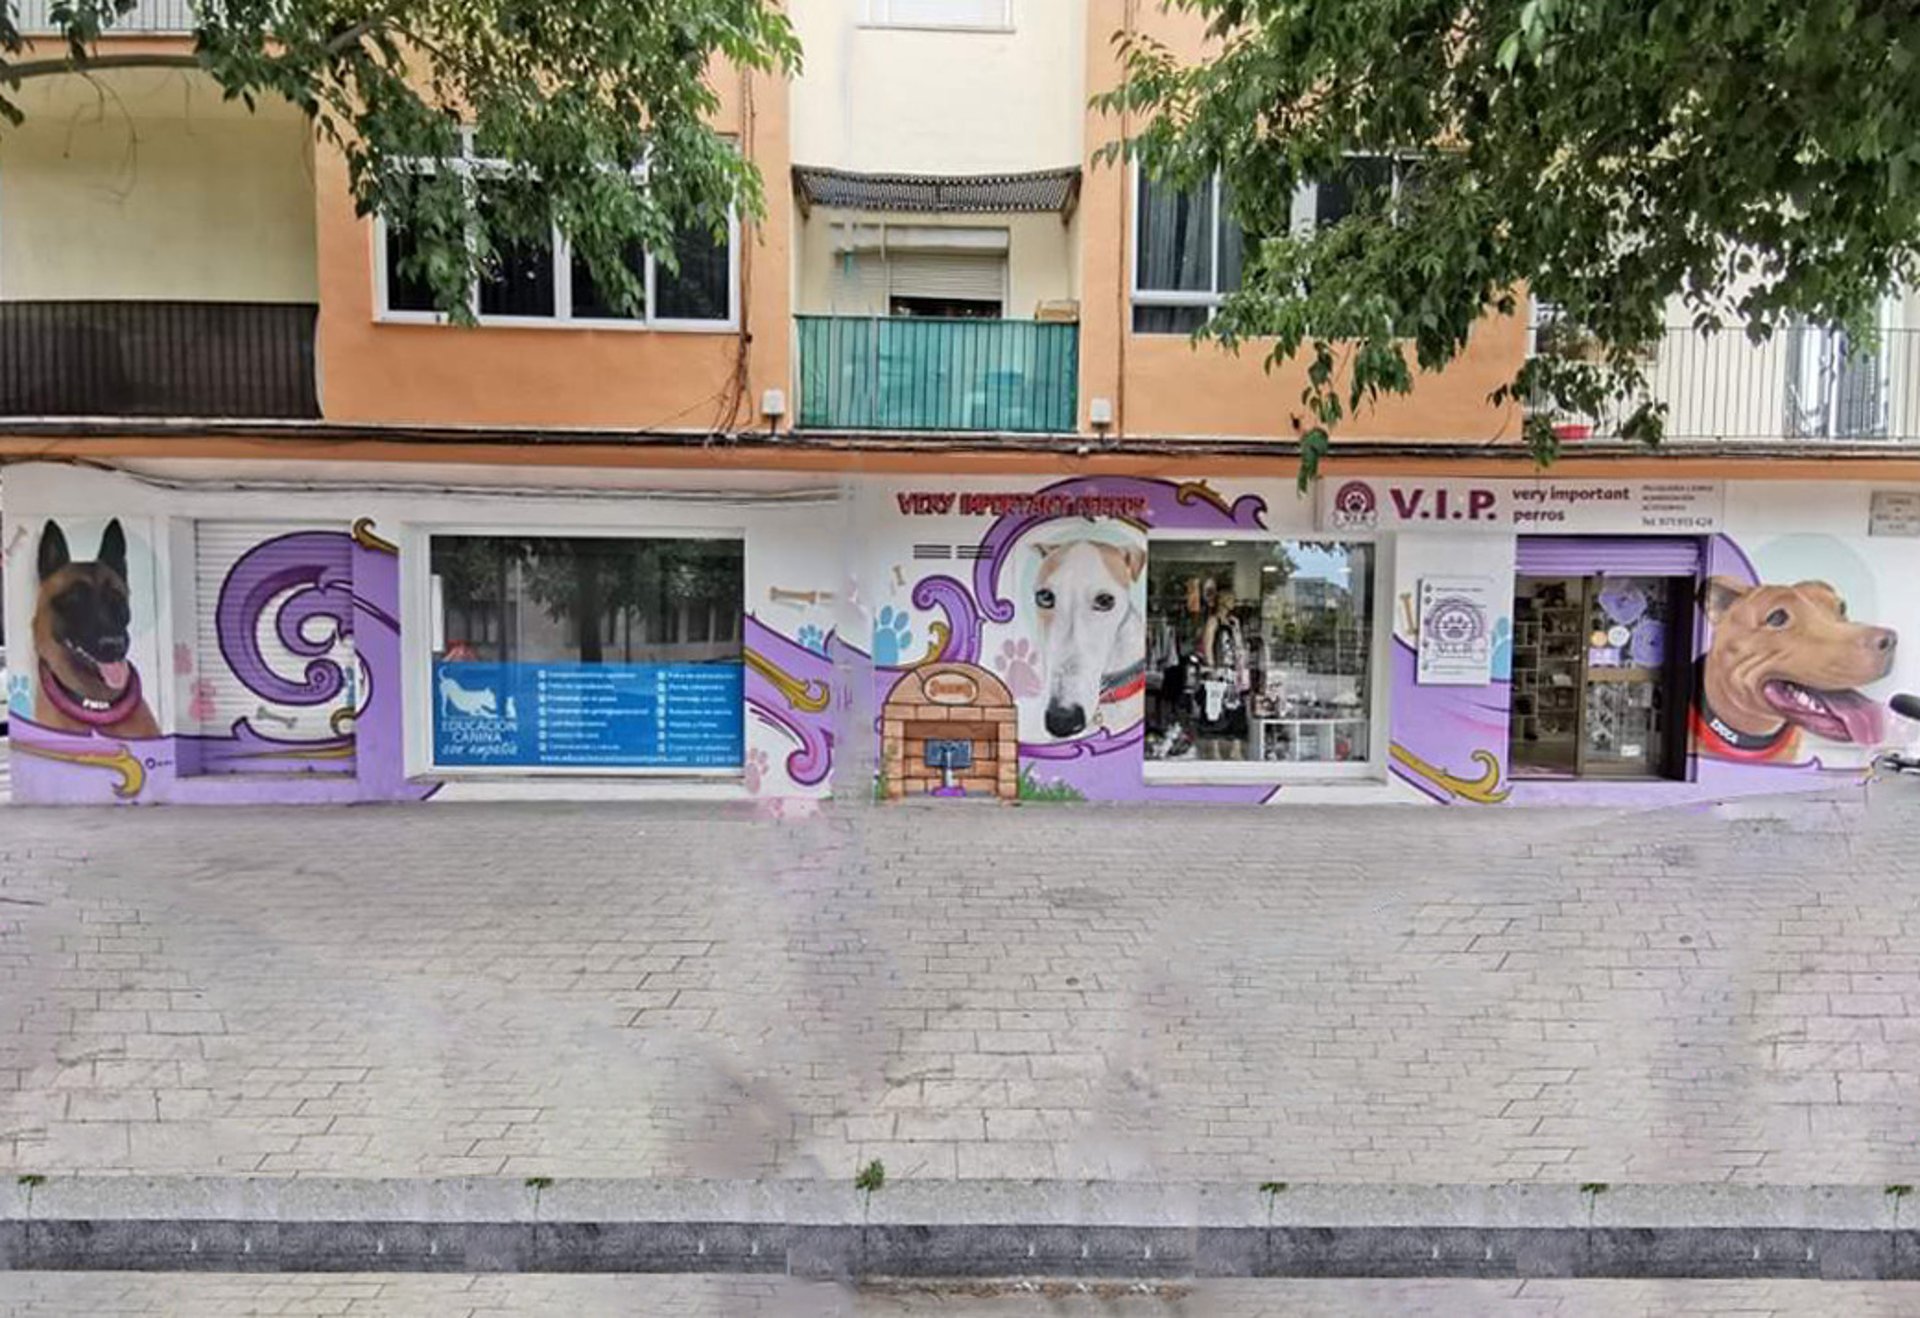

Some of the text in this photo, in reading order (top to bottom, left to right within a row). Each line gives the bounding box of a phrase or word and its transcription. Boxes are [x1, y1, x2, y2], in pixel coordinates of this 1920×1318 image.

[1512, 489, 1547, 503] very
[1551, 485, 1629, 503] important
[897, 492, 956, 515] VERY
[1389, 489, 1496, 520] V.I.P.
[1513, 510, 1564, 524] perros
[452, 730, 502, 743] CANINA
